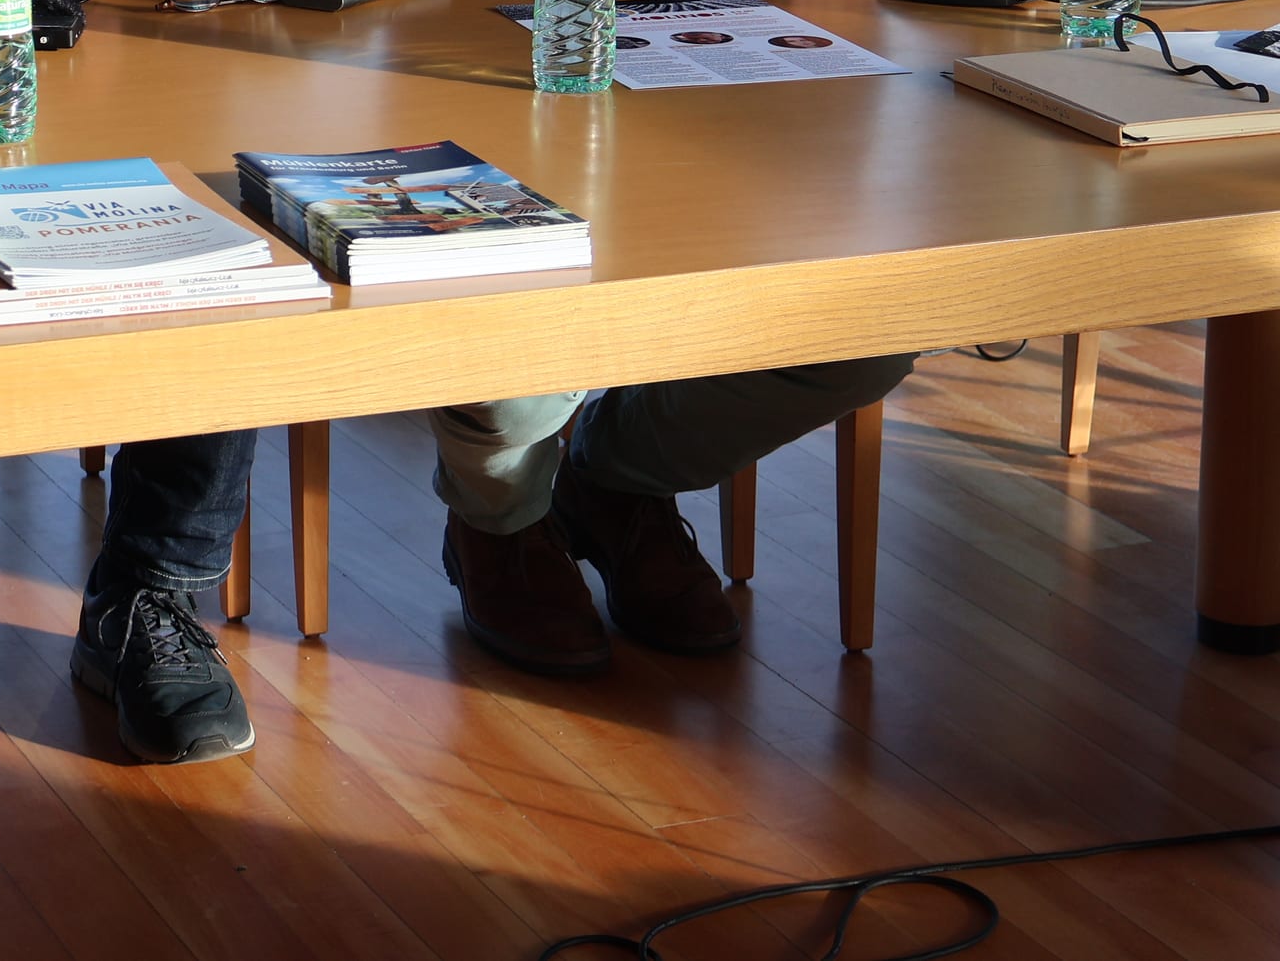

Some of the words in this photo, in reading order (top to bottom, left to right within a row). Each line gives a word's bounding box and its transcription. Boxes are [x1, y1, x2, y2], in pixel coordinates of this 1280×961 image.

[260, 157, 399, 168] Mühlenkarte
[1, 181, 50, 192] Mapa
[83, 201, 125, 211] VIA
[92, 204, 183, 219] MOLINA
[37, 214, 203, 238] POMERANIA
